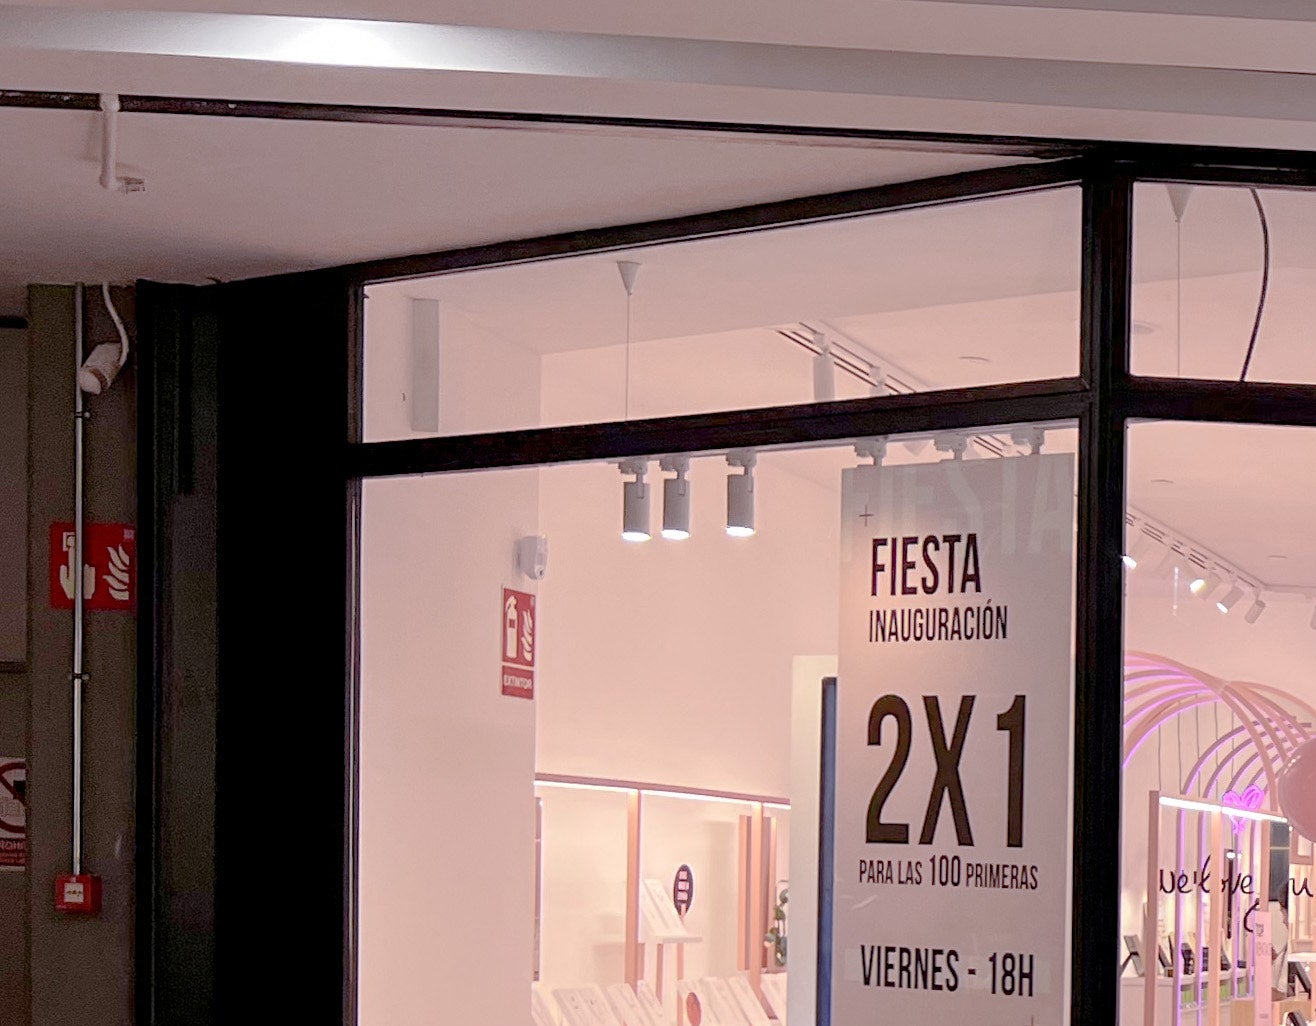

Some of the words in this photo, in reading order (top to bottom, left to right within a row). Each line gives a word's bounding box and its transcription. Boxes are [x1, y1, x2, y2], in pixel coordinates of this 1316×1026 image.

[870, 533, 983, 598] FIESTA
[868, 599, 1009, 644] INAUGURACIÓN
[859, 859, 894, 884] PARA
[898, 860, 923, 886] LAS
[929, 854, 961, 887] 100
[966, 862, 1039, 891] PRIMERAS
[860, 944, 960, 993] VIERNES
[988, 951, 1035, 998] 18H
